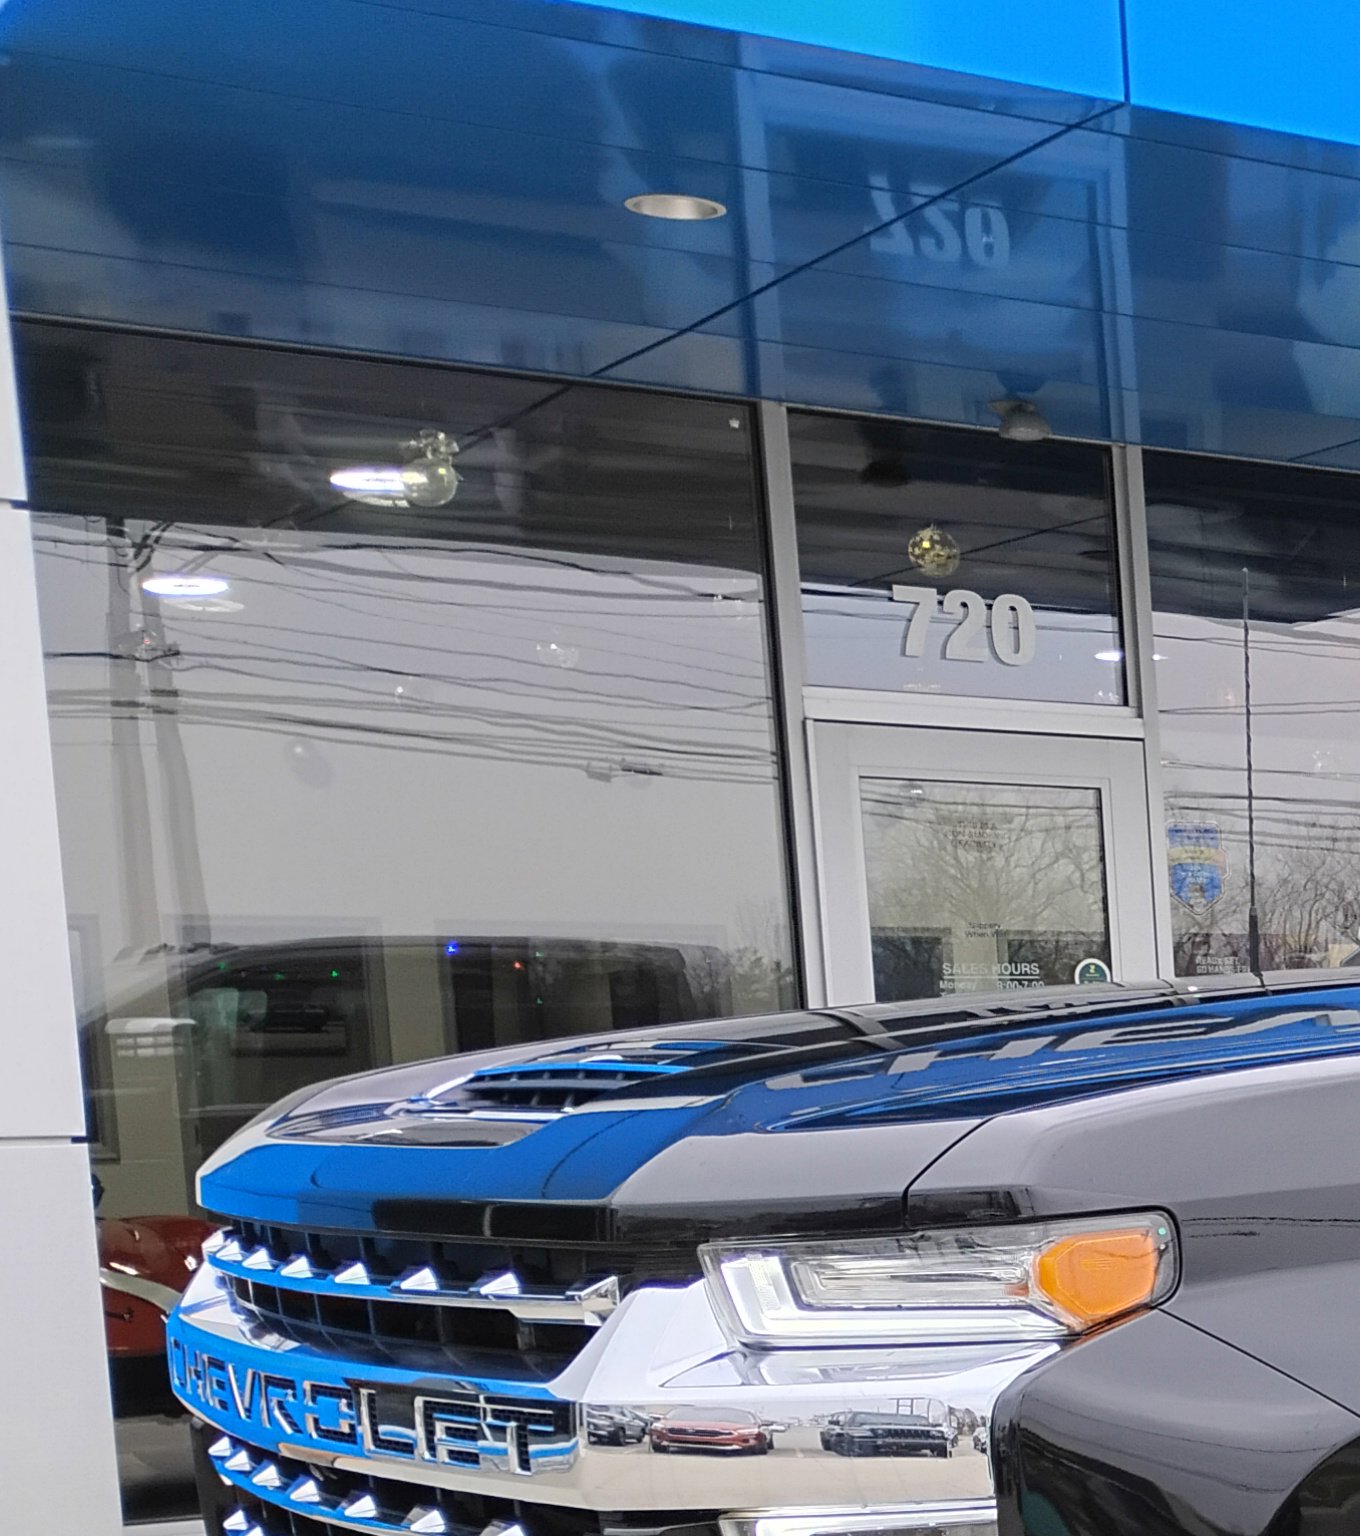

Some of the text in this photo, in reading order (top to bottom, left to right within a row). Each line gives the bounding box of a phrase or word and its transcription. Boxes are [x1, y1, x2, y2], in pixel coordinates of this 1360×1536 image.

[891, 584, 1037, 667] 720
[942, 962, 1040, 975] SALES HOURS
[170, 1338, 556, 1477] CHEVROLET
